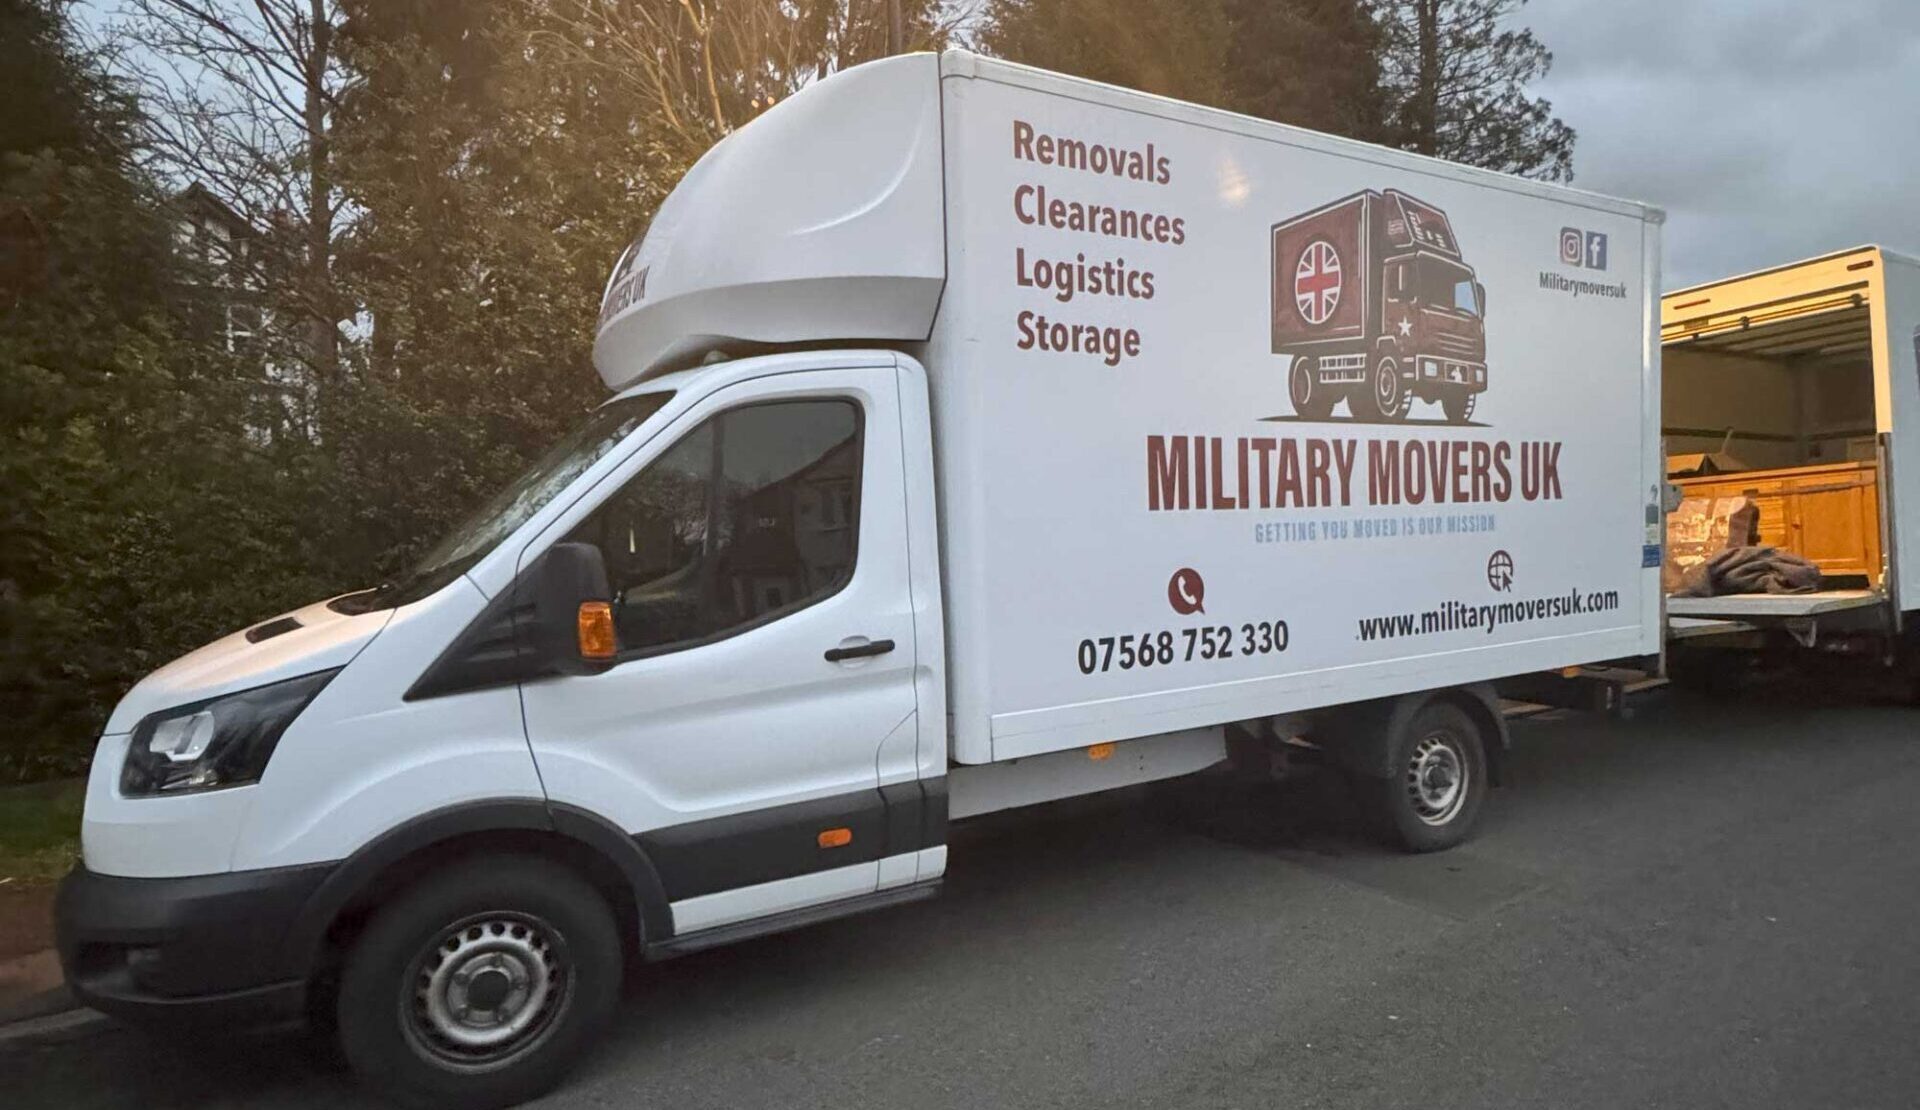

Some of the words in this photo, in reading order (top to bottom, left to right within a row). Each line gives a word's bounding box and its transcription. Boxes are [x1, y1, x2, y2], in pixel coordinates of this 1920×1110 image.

[1013, 119, 1171, 185] Removals
[1014, 182, 1185, 246] Clearances
[1016, 247, 1155, 303] Logistics
[1539, 271, 1627, 299] Militarymoversuk
[1016, 310, 1141, 367] Storage
[1147, 435, 1357, 511] MILITARY
[1368, 439, 1513, 506] MOVERS
[1520, 441, 1563, 502] UK
[1255, 520, 1317, 544] GETTING
[1321, 520, 1348, 540] YOU
[1353, 518, 1398, 539] MOVED
[1401, 516, 1416, 536] IS
[1418, 516, 1443, 536] OUR
[1446, 514, 1495, 533] MISSION
[1358, 587, 1619, 641] www.militarymoversuk.com
[1078, 630, 1174, 675] 07568
[1182, 625, 1233, 662] 752
[1241, 620, 1289, 656] 330
